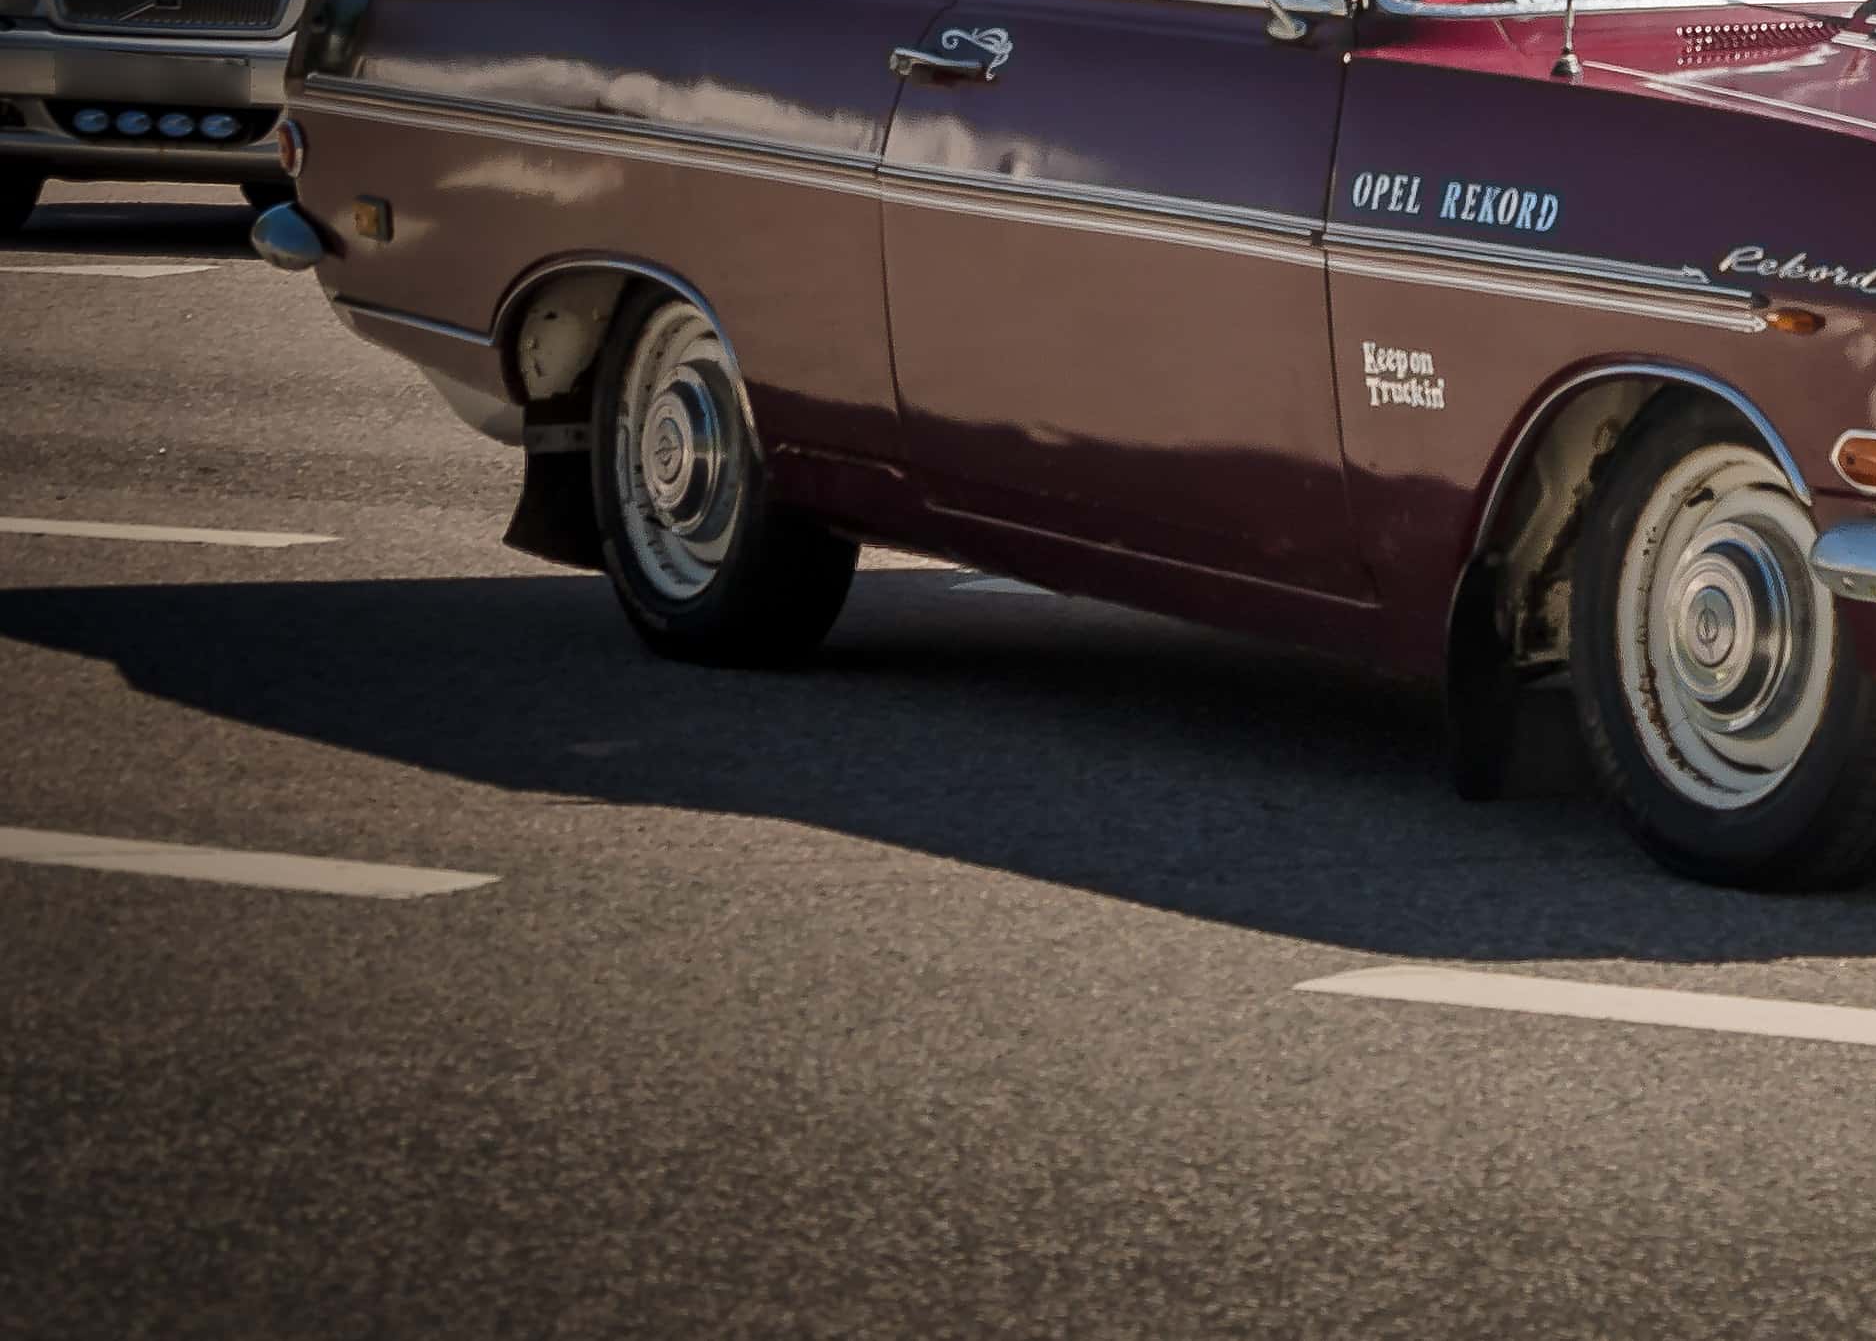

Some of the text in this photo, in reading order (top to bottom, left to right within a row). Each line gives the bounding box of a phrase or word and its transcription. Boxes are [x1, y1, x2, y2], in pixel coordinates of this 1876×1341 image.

[1352, 171, 1559, 232] OPEL REKORD
[1362, 341, 1434, 379] Keep on
[1365, 376, 1445, 409] Truckin'
